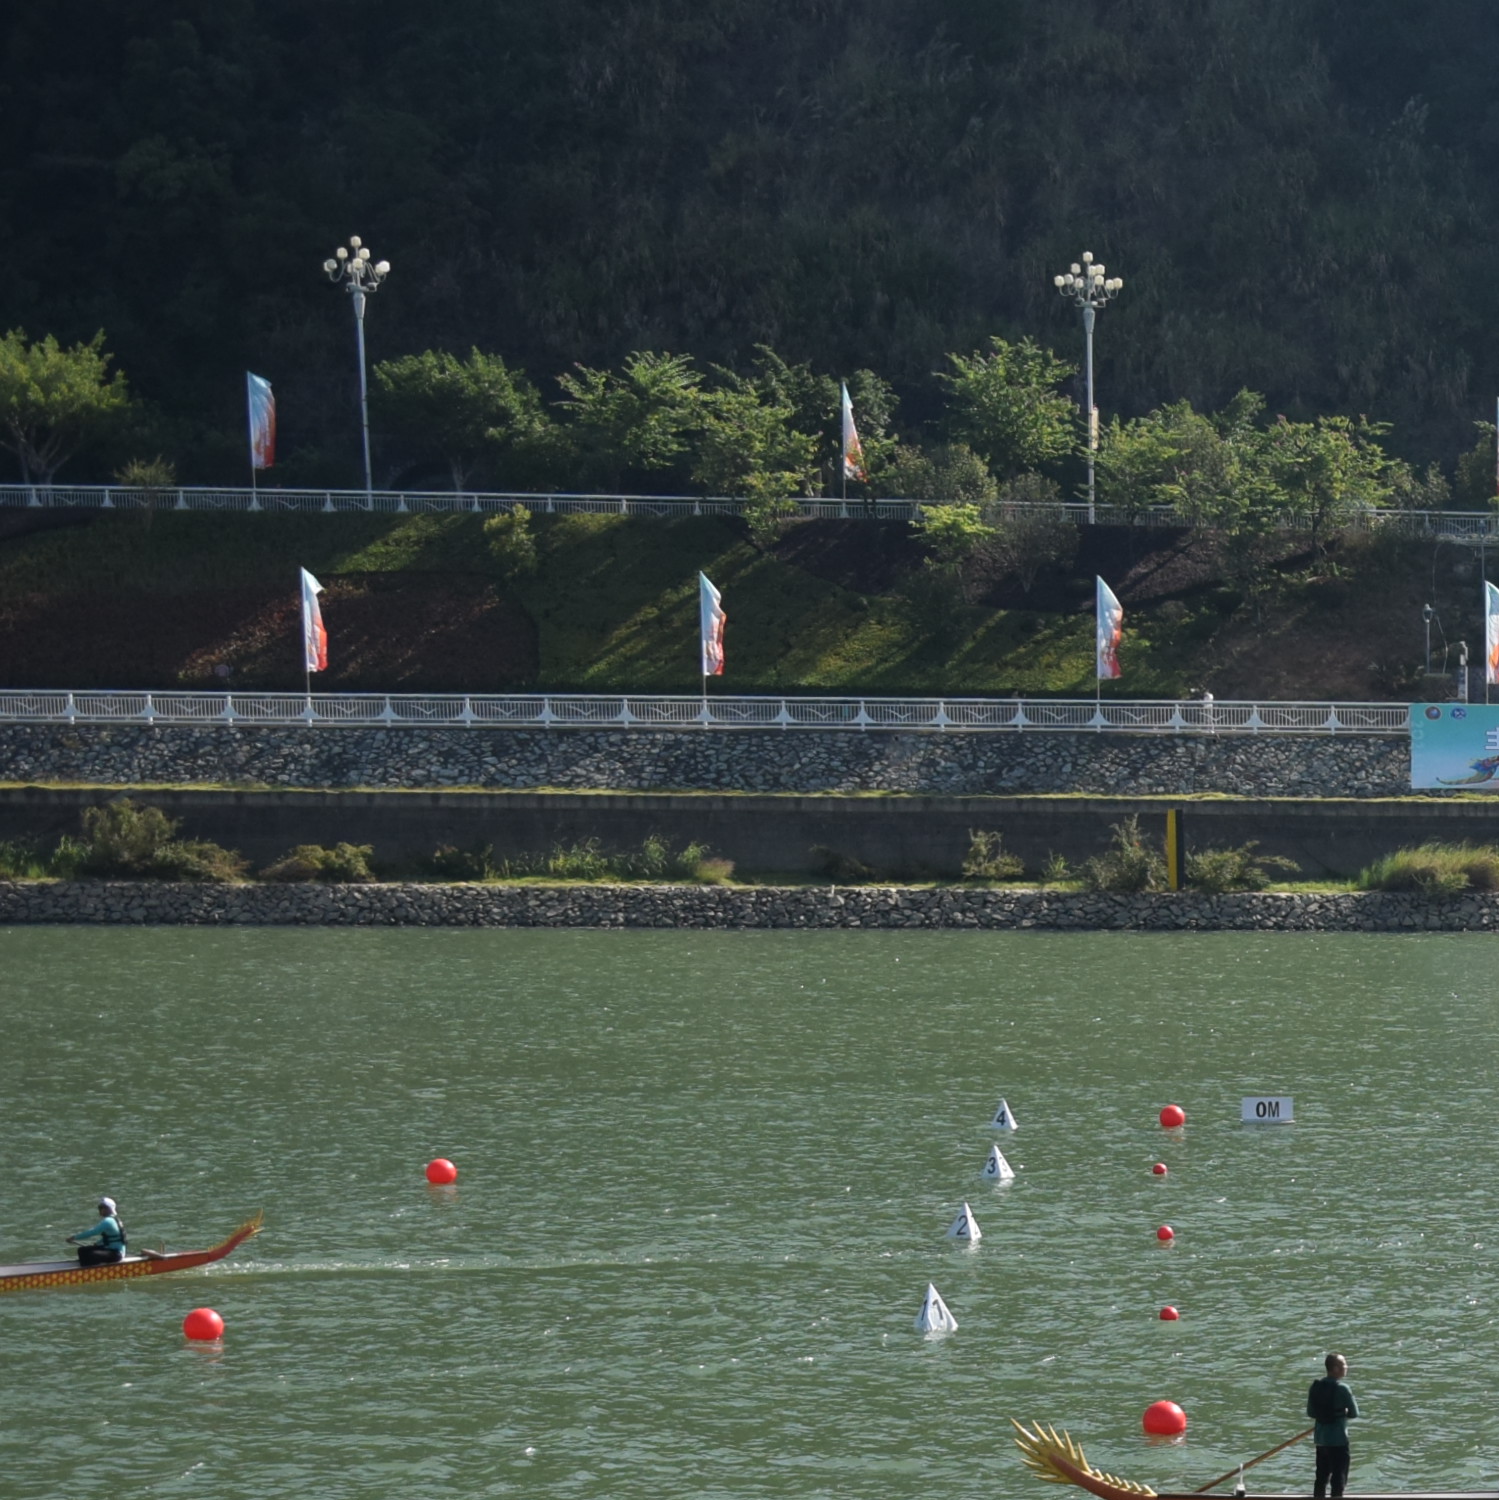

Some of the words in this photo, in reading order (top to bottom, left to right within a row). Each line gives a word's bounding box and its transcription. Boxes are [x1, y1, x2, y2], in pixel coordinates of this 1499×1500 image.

[996, 1110, 1006, 1126] 4
[987, 1157, 996, 1174] 3
[956, 1215, 968, 1236] 2
[932, 1299, 944, 1320] 1
